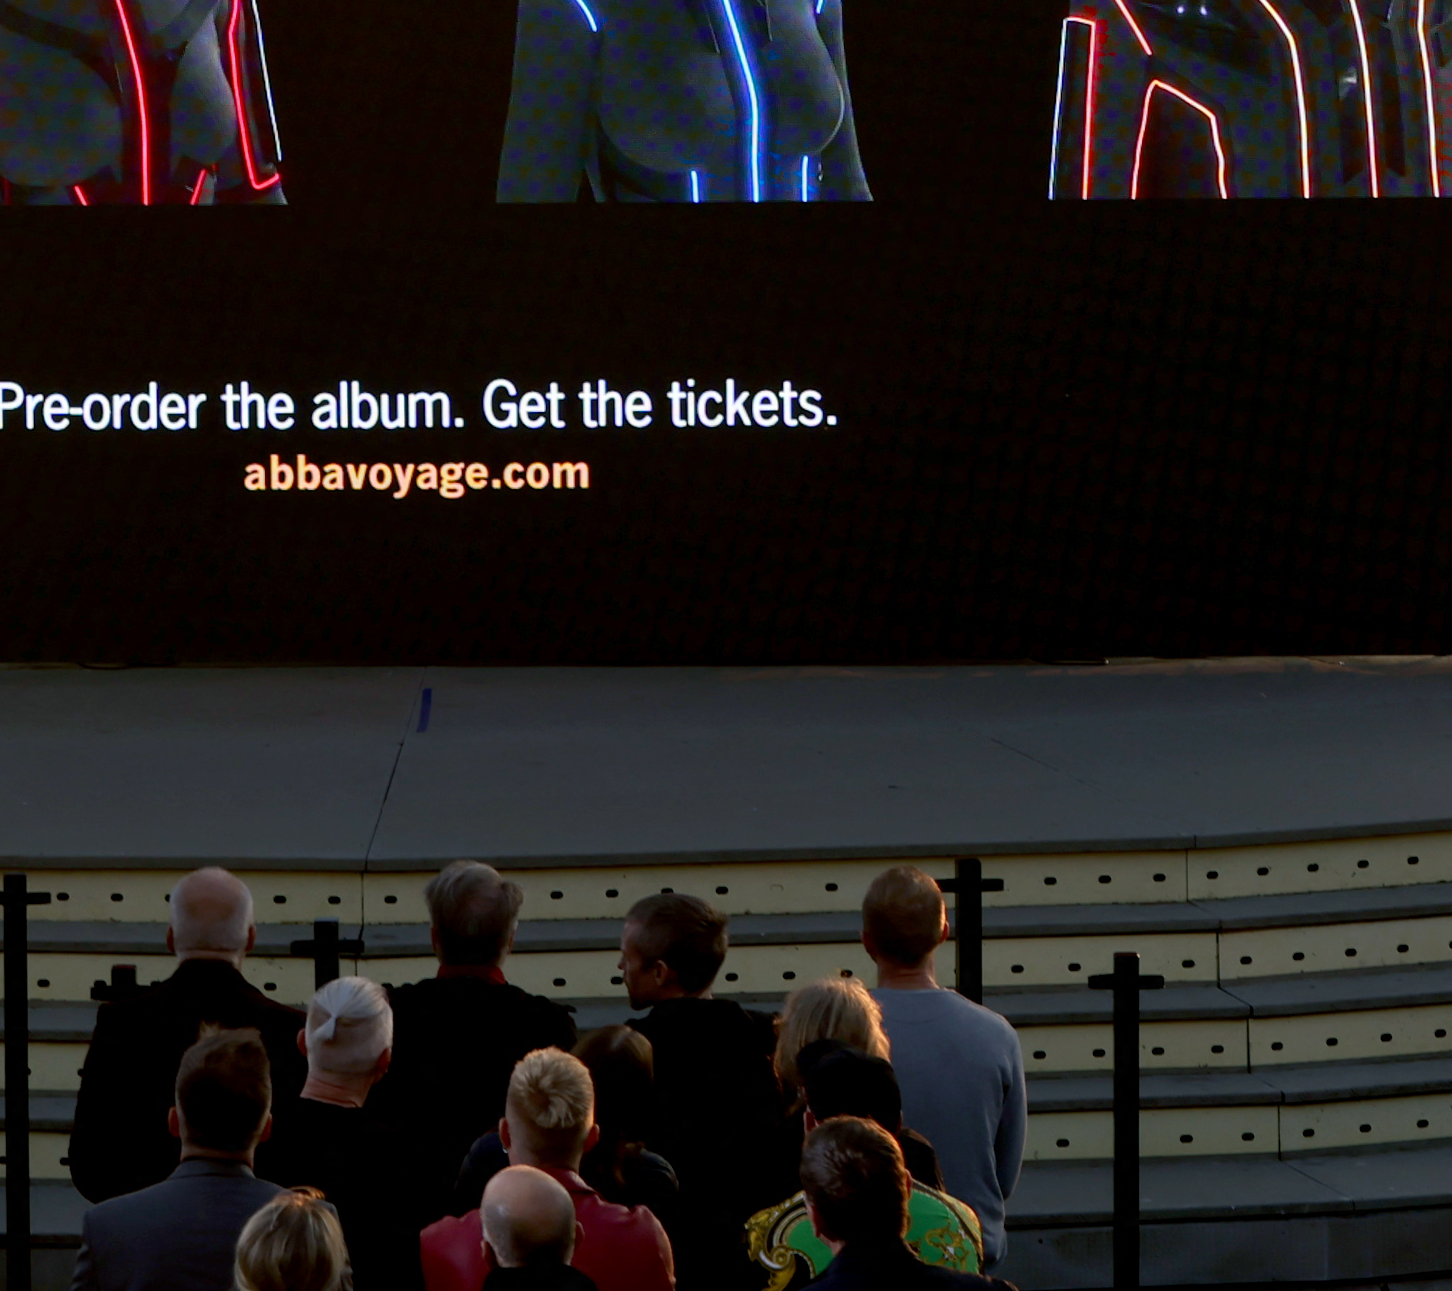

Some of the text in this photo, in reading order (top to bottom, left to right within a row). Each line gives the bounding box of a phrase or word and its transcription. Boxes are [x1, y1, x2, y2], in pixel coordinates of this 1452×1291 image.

[220, 381, 295, 430] the
[312, 380, 465, 429] album.
[483, 379, 566, 429] Get
[578, 379, 653, 428] the
[667, 378, 838, 428] tickets.
[244, 453, 590, 499] abbavoyage.com
